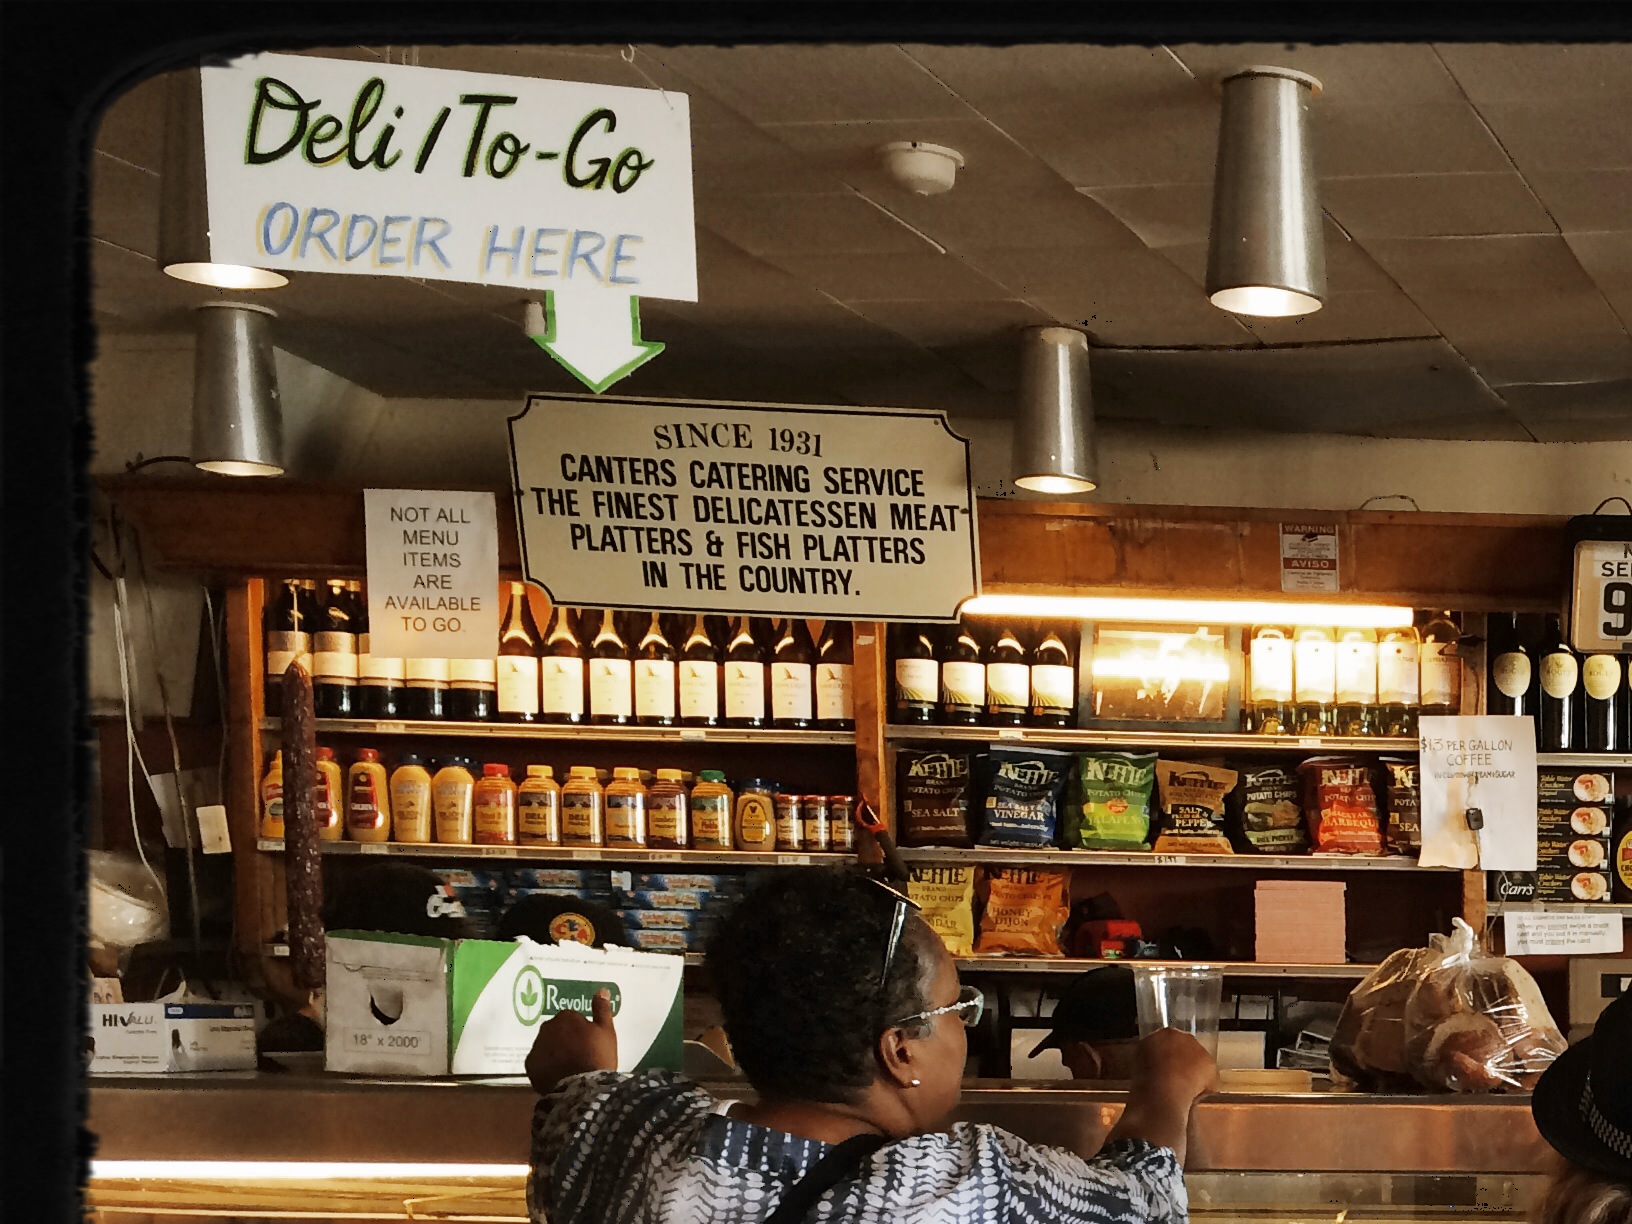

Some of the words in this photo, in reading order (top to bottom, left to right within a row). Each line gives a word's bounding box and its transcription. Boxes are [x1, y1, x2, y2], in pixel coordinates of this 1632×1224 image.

[257, 202, 453, 272] ORDER
[480, 224, 644, 285] HERE
[654, 423, 753, 450] SINCE
[768, 428, 823, 457] 1931
[560, 454, 677, 488] CANTERS
[690, 460, 810, 493] CATERING
[824, 467, 924, 497] SERVICE
[390, 507, 430, 524] NOT
[436, 507, 471, 524] ALL
[532, 487, 580, 516] THE
[593, 490, 678, 521] FINEST
[694, 495, 876, 529] DELICATESSEN
[890, 503, 960, 532] MEAT
[1284, 525, 1334, 533] WARNING
[402, 530, 460, 546] MENU
[570, 524, 692, 556] PLATTERS
[706, 530, 725, 557] &
[737, 531, 791, 560] FISH
[803, 535, 926, 565] PLATTERS
[402, 552, 462, 568] ITEMS
[1291, 560, 1329, 568] AVISO
[413, 574, 453, 590] ARE
[642, 562, 668, 588] IN
[679, 564, 727, 591] THE
[739, 566, 861, 596] COUNTRY.
[385, 595, 482, 612] AVAILABLE
[400, 617, 428, 633] TO
[1446, 740, 1466, 751] PER
[1468, 739, 1512, 751] GALLON
[1446, 753, 1492, 766] COFFEE
[911, 808, 931, 818] SEA
[933, 807, 960, 818] SALT
[993, 809, 1045, 822] VINEGAR
[1500, 881, 1534, 895] Carr's
[992, 906, 1033, 917] HONEY
[377, 1037, 384, 1046] x
